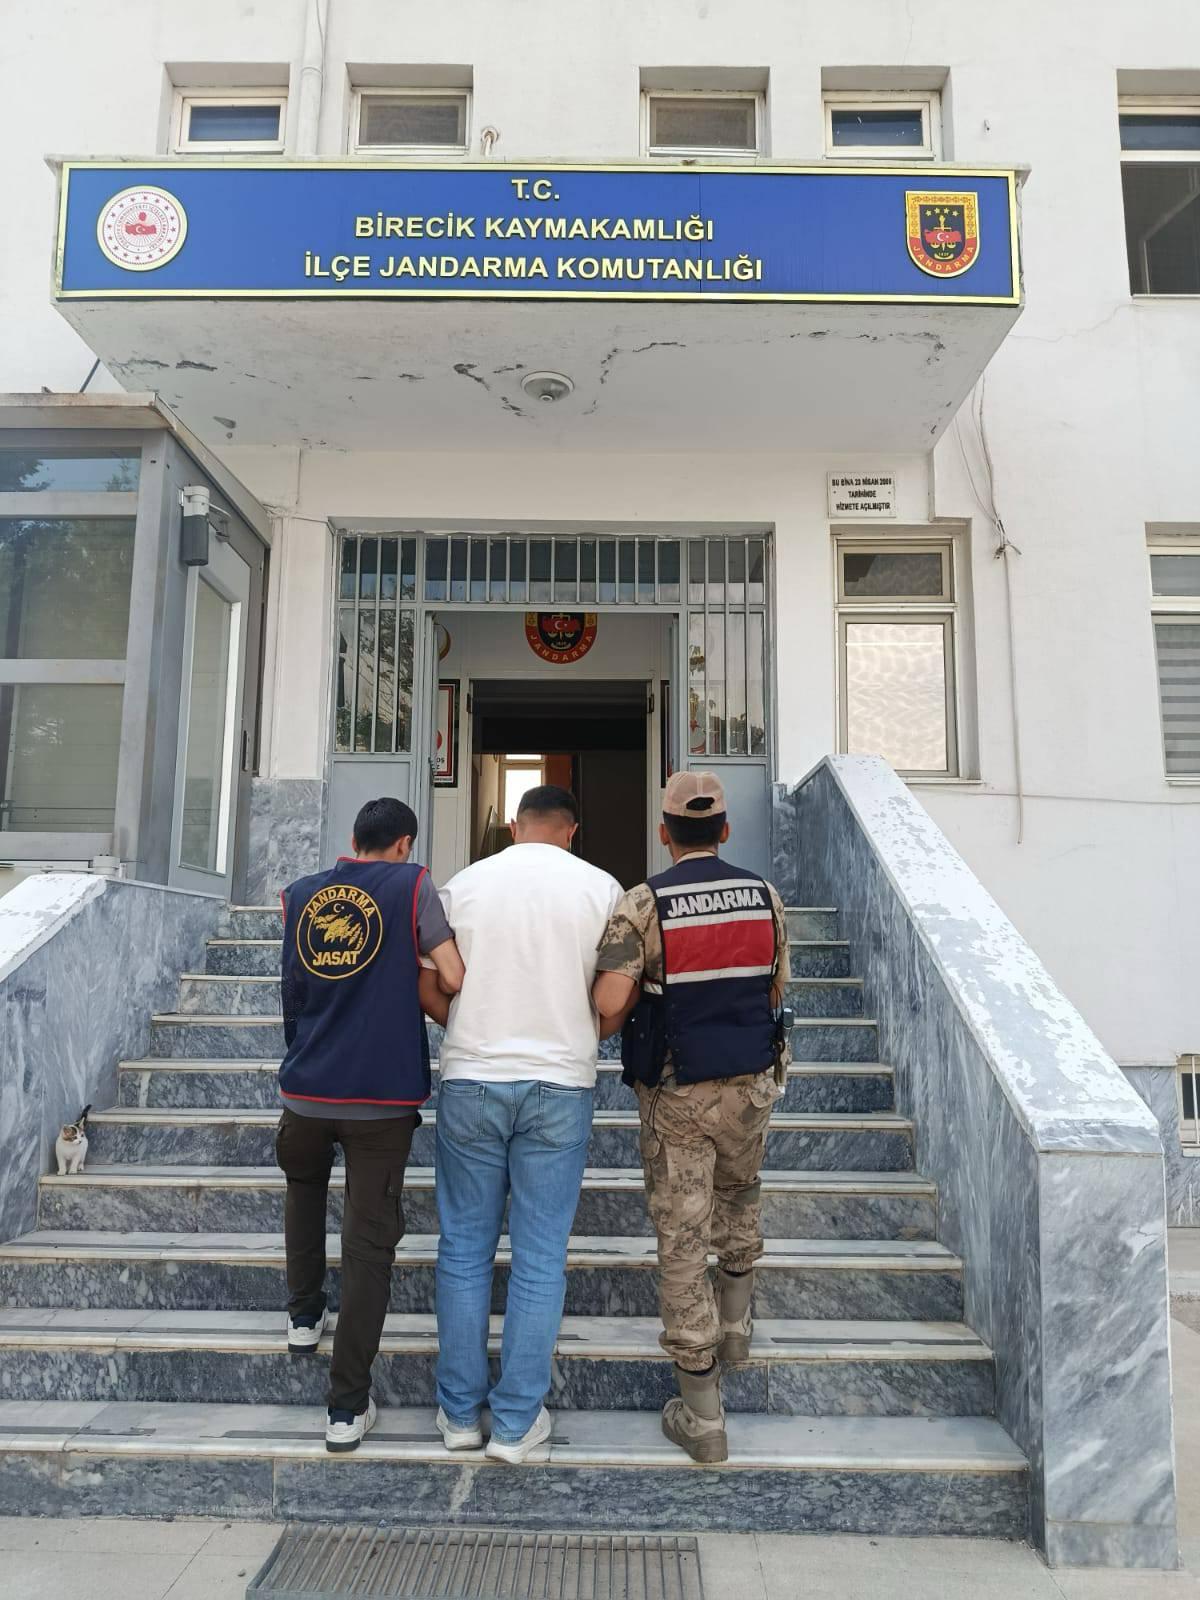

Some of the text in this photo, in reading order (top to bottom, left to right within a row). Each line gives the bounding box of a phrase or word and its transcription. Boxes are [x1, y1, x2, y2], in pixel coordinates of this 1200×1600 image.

[511, 179, 560, 199] T.C.
[355, 212, 713, 241] BİRECİK KAYMAKAMLIĞI
[305, 251, 762, 282] İLÇE JANDARMA KOMUTANLIĞI
[913, 246, 974, 271] JANDARMA
[841, 477, 854, 486] BİNA
[862, 476, 879, 486] NİSAN
[848, 489, 877, 498] TARİHİNDE
[836, 501, 891, 511] HİZMETE AÇILMIŞTIR
[530, 635, 593, 661] JANDARMA
[306, 887, 376, 918] JANDARMA
[667, 888, 766, 918] JANDARMA
[312, 950, 360, 966] JASAT
